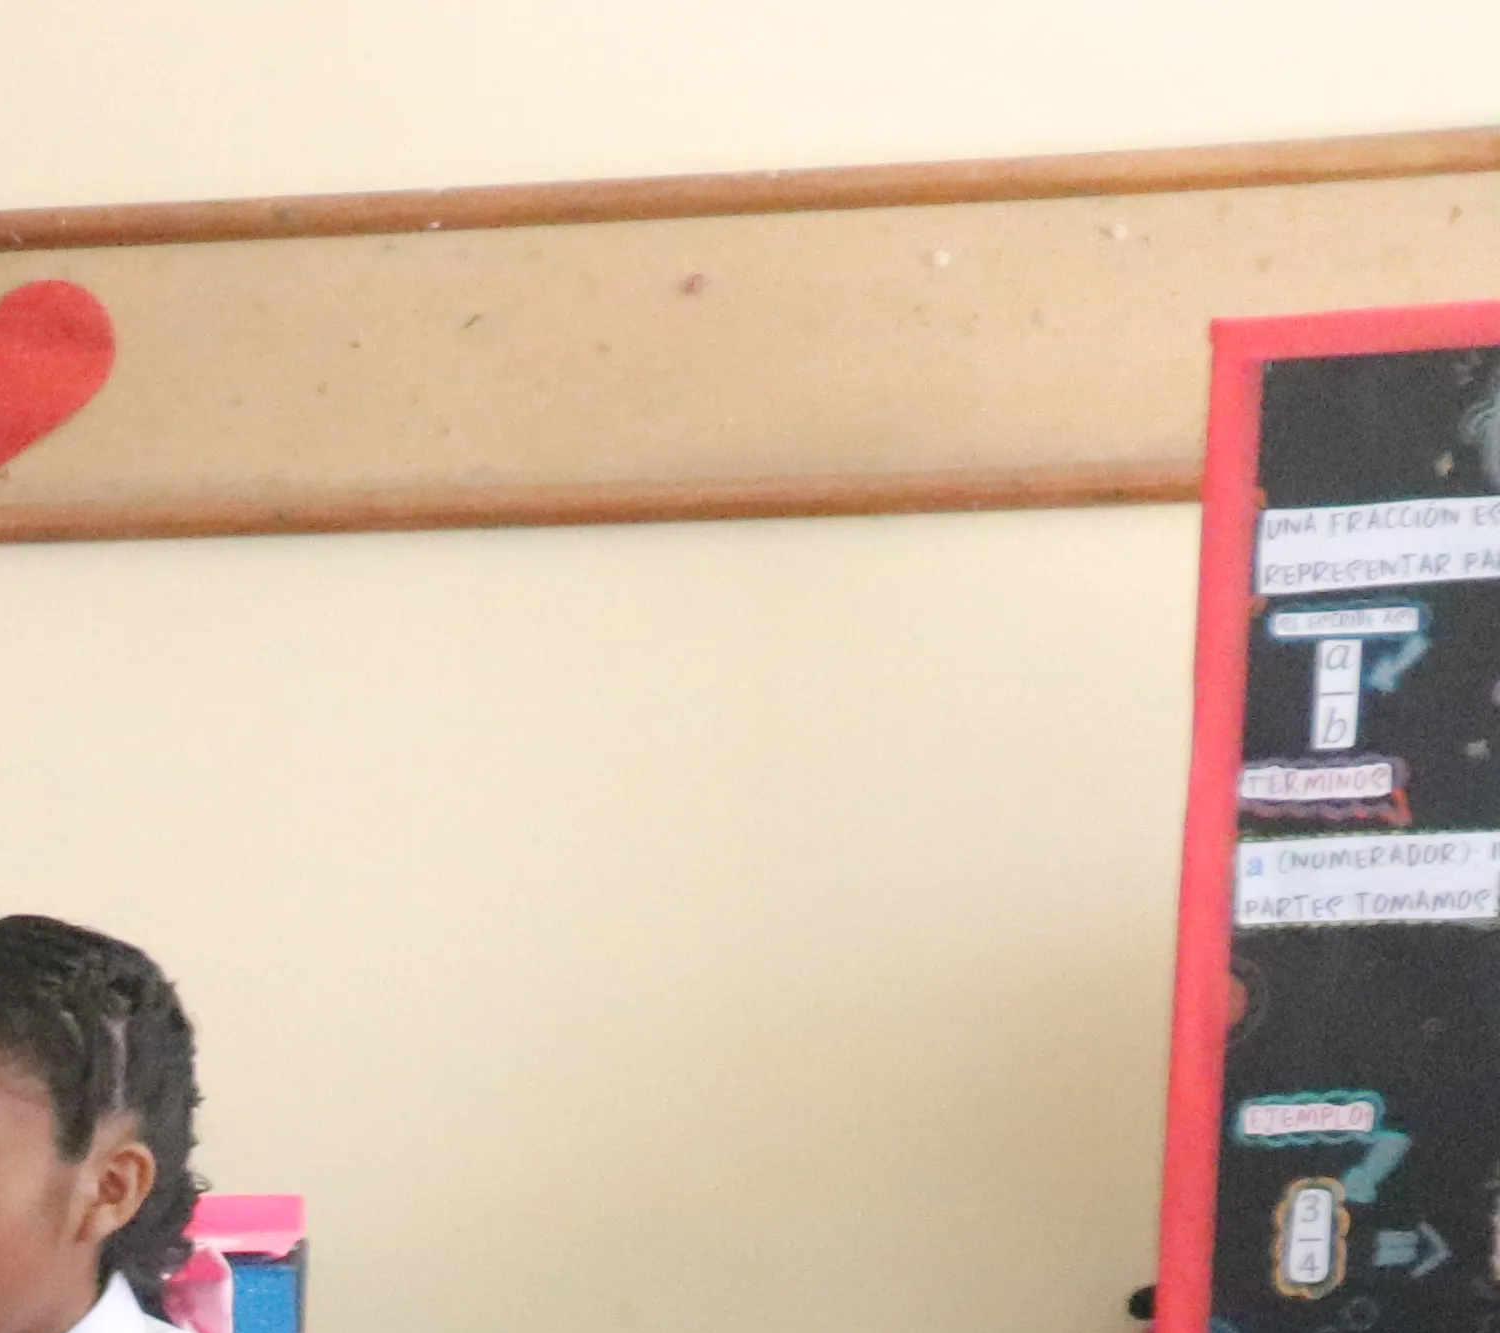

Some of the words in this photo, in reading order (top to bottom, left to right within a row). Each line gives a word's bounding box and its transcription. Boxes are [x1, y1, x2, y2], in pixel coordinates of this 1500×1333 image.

[1267, 512, 1316, 540] UNA
[1265, 552, 1451, 586] REPRESENTAR
[1464, 548, 1500, 575] PA
[1244, 894, 1343, 919] PARTES
[1356, 889, 1491, 915] TOMAMOS
[1300, 1194, 1320, 1223] 3
[1299, 1252, 1321, 1279] 4
